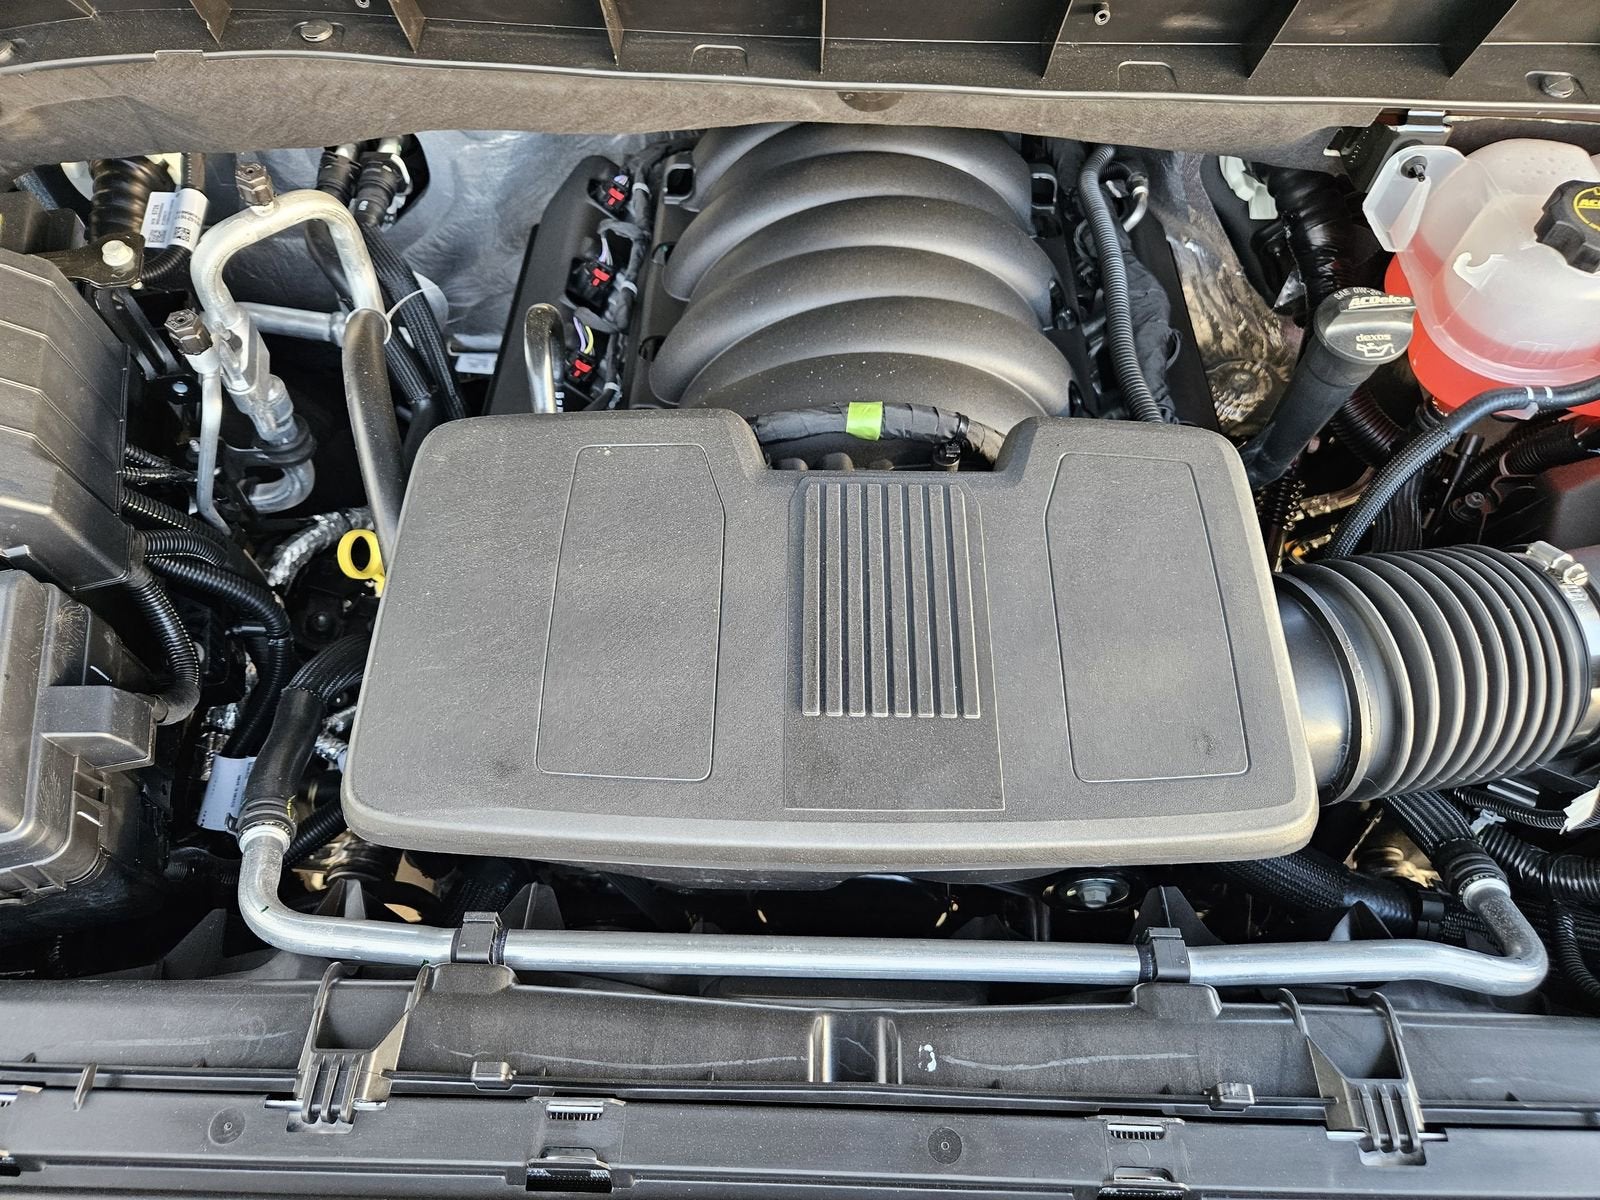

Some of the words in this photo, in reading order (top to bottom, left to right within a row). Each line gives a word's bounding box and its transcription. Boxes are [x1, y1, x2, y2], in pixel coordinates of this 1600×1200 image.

[1579, 198, 1600, 207] AC
[1334, 289, 1351, 299] SAE
[1348, 295, 1411, 308] ACDelco
[1355, 333, 1392, 342] dexos
